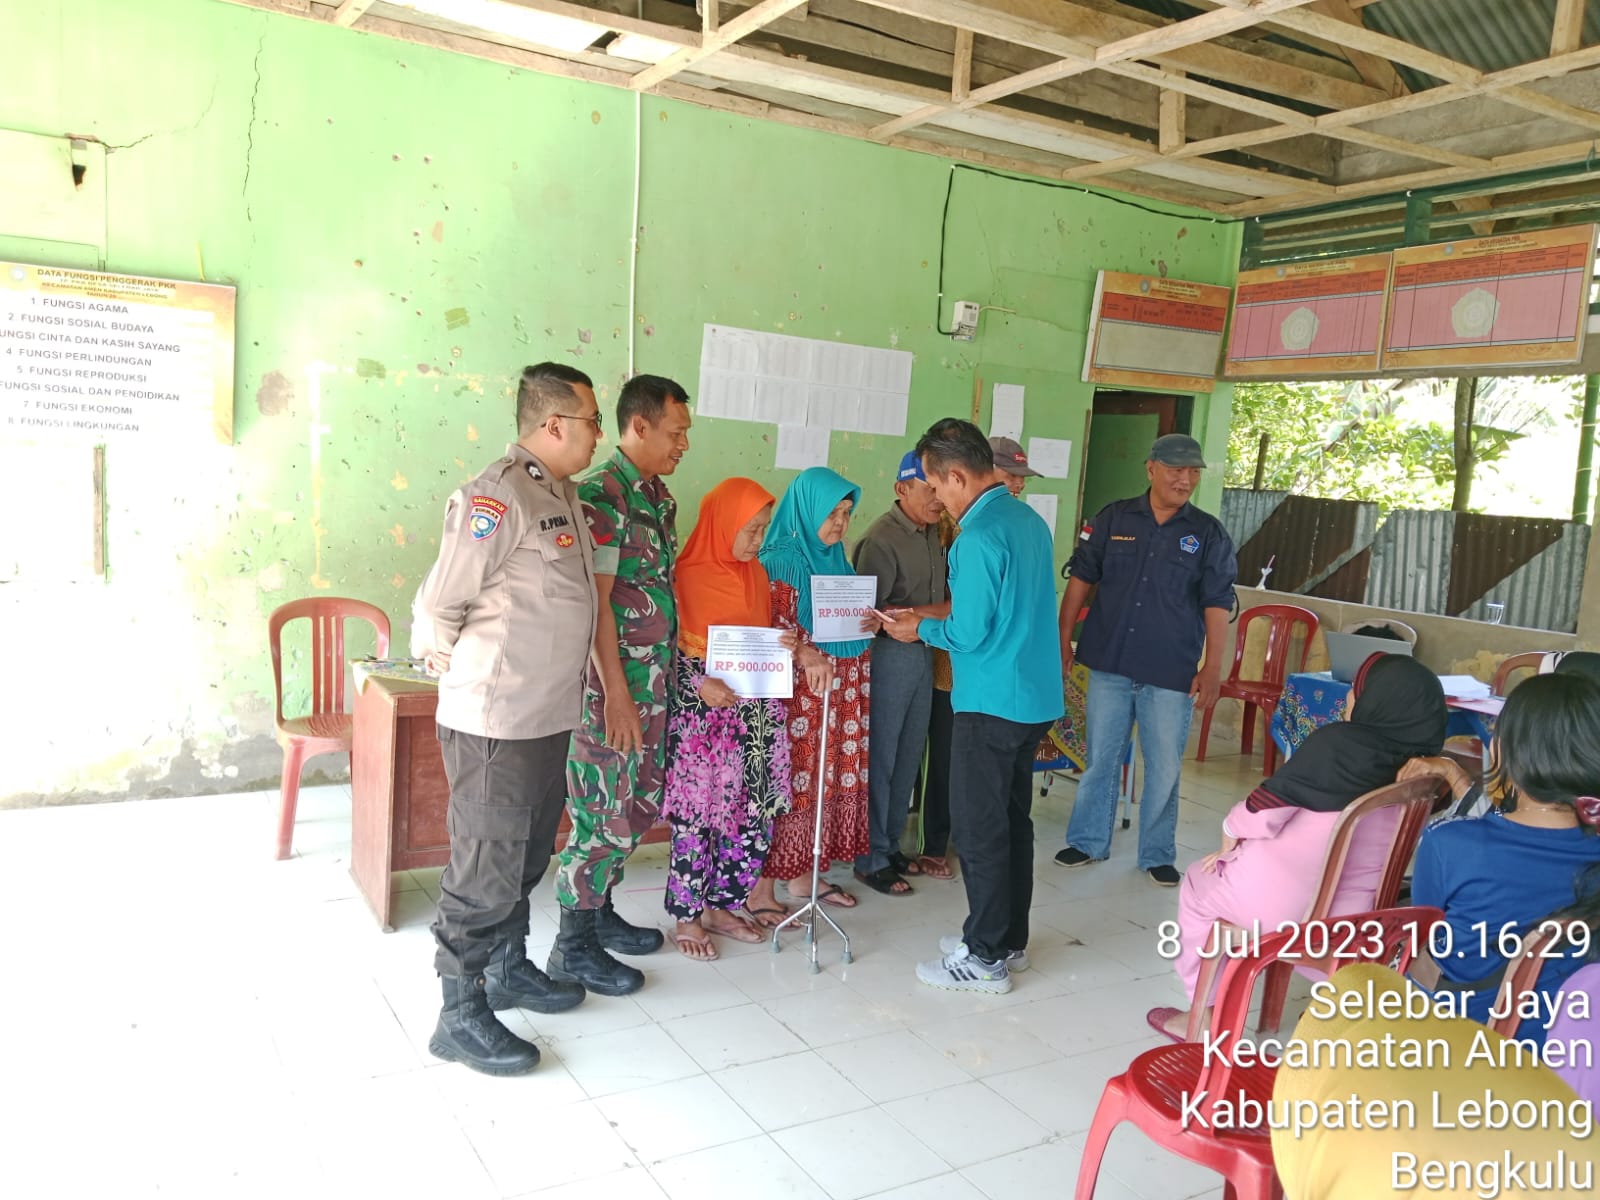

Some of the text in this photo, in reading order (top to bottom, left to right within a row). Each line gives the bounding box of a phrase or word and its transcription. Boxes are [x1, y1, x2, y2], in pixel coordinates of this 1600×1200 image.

[37, 268, 177, 289] DATA FUNGSI PENGGERAK PKK
[43, 298, 86, 310] FUNGSI
[88, 303, 129, 314] AGAMA
[21, 313, 64, 325] FUNGSI
[67, 318, 108, 329] SOSIAL
[111, 322, 155, 333] BUDAYA
[0, 329, 181, 353] UNGSI CINTA DAN KASIH SAYANG
[19, 348, 62, 360] FUNGSI
[65, 351, 152, 367] PERLINDUNGAN
[29, 366, 72, 377] FUNGSI
[75, 369, 147, 383] REPRODUKSI
[44, 384, 85, 395] SOSIAL
[88, 387, 112, 396] DAN
[115, 388, 180, 401] PENDIDIKAN
[36, 401, 78, 412] FUNGSI
[81, 404, 132, 415] EKONOMI
[20, 417, 63, 428] FUNGSI
[67, 420, 139, 432] LINGKUNGAN
[714, 660, 784, 673] RP.900.000
